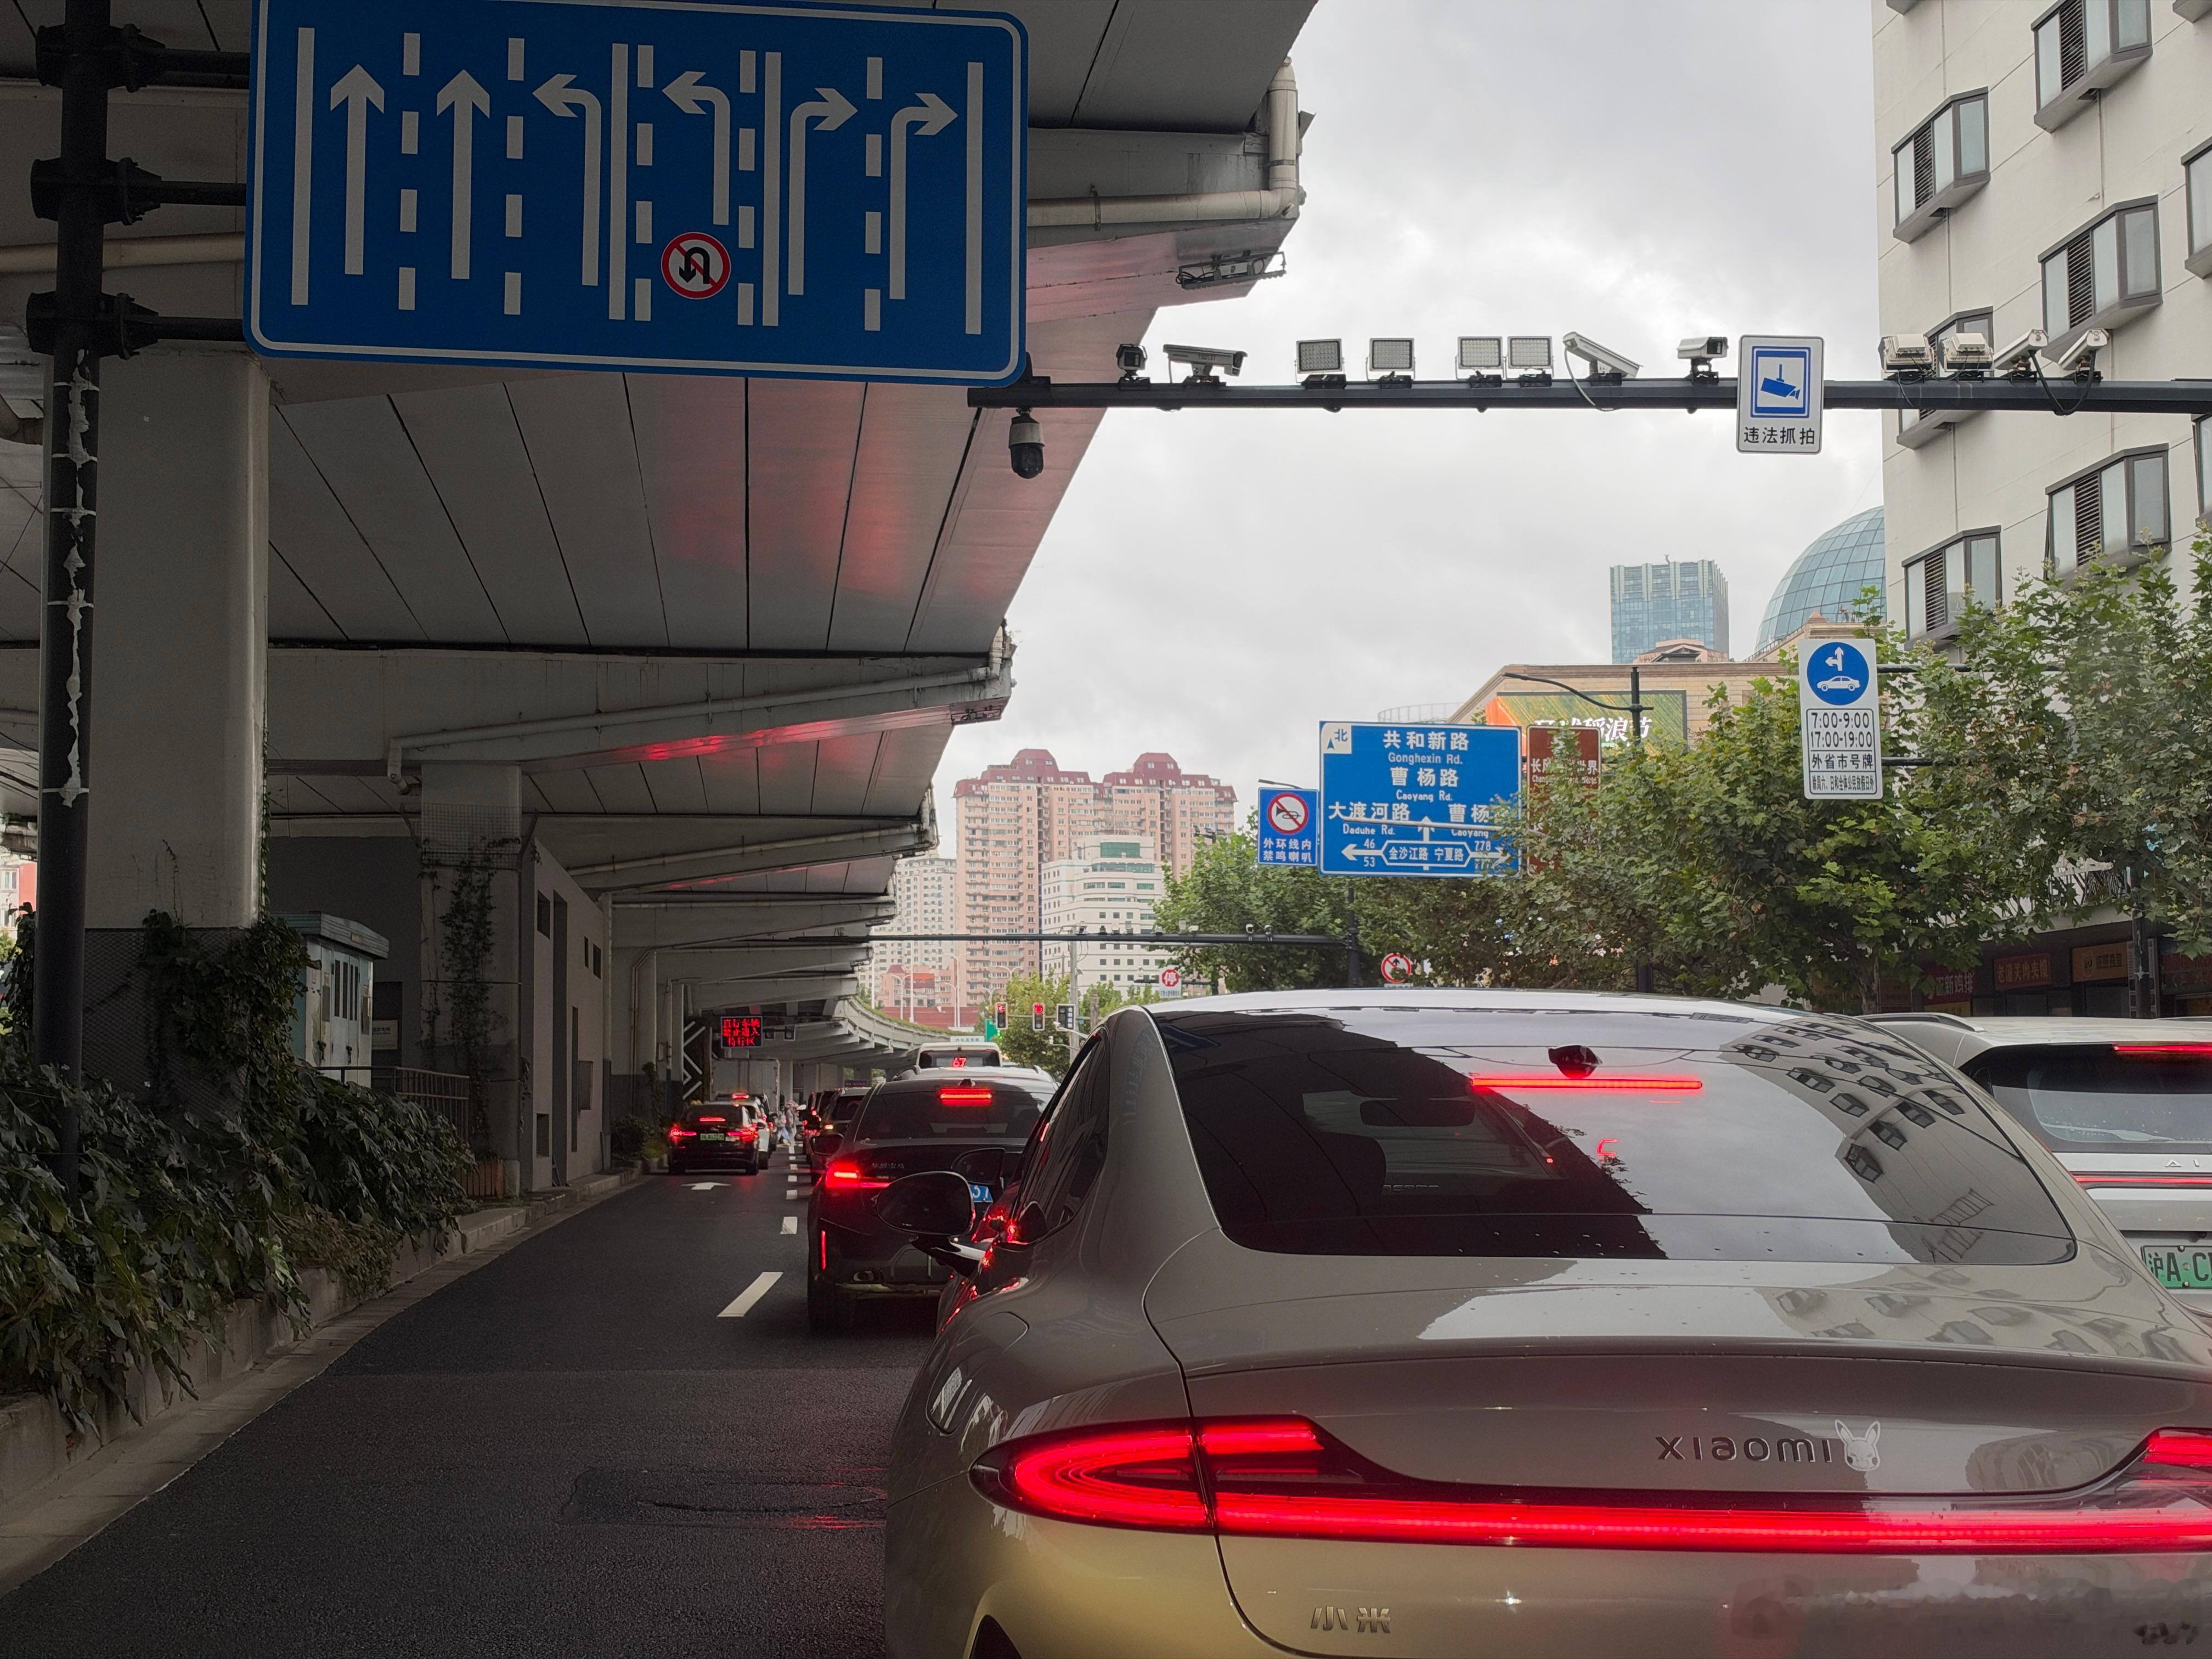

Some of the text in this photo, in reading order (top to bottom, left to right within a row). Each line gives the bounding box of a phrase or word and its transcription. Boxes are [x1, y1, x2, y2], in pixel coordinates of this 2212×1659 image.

[1743, 427, 1815, 445] 违法抓拍
[1811, 712, 1869, 729] 7:00-9:00
[1334, 729, 1347, 742] 北
[1383, 730, 1469, 751] 共和新路
[1811, 731, 1872, 748] 17:00-19:00
[1388, 752, 1463, 765] Gonghexin Rd.
[1812, 753, 1873, 769] 外省市号牌
[1390, 767, 1458, 787] 曹杨路
[1396, 789, 1453, 802] Caoyang Rd.
[1328, 802, 1410, 821] 大渡河路
[1343, 823, 1395, 835] Daduhe Rd.
[1263, 838, 1312, 850] 外环线内
[1364, 838, 1375, 849] 46
[1475, 840, 1491, 850] 778
[1263, 850, 1312, 862] 禁鸣喇叭
[1389, 847, 1464, 861] 金沙江路 宁夏路
[1363, 856, 1375, 867] 53
[1164, 972, 1177, 985] 停
[952, 1057, 967, 1067] 67
[1655, 1436, 1832, 1463] xiaomi
[1311, 1605, 1391, 1634] 小米
